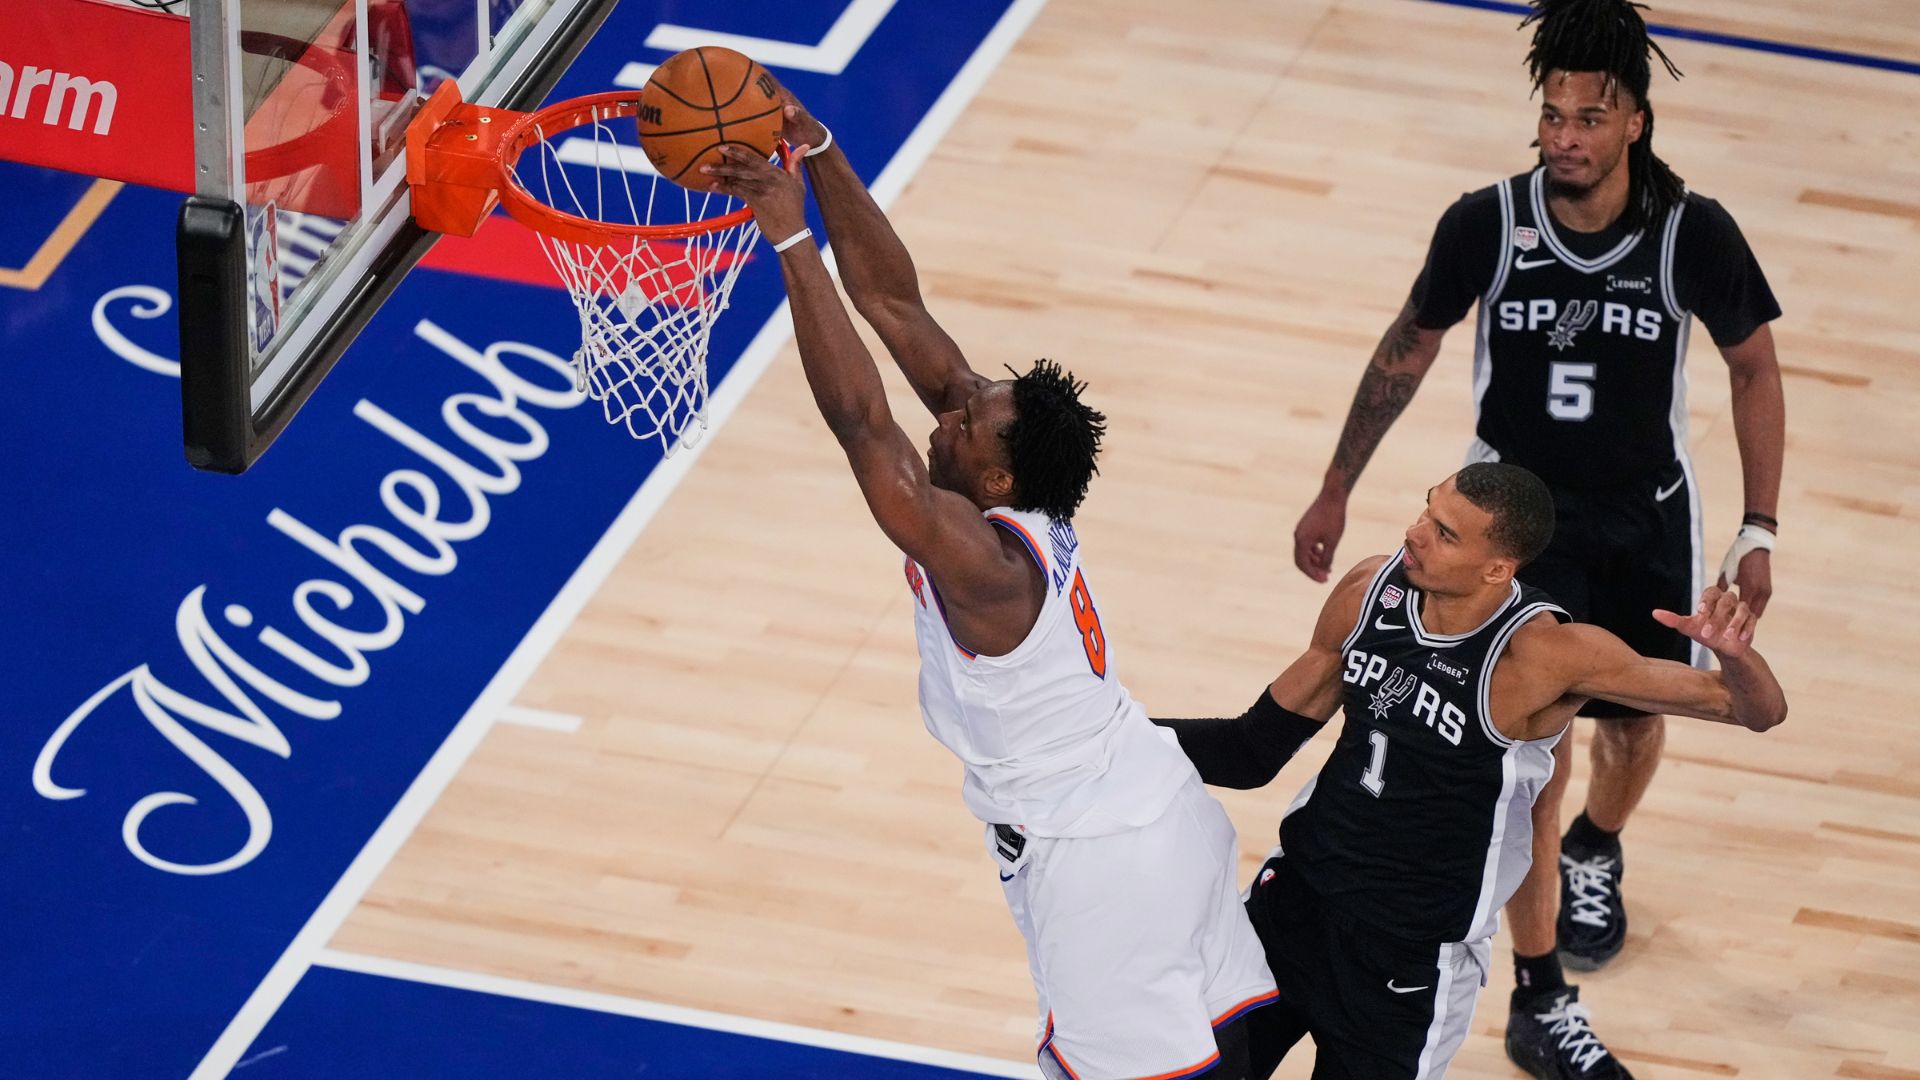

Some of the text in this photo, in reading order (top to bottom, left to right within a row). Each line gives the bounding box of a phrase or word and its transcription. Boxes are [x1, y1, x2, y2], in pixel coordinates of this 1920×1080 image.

[1611, 279, 1646, 290] LEDGER
[1499, 299, 1662, 351] SPURS
[1547, 361, 1597, 421] 5
[32, 318, 588, 875] Michelob
[1069, 566, 1106, 681] 8
[1343, 649, 1467, 746] SPURS
[1432, 658, 1462, 679] LEDGER
[1359, 729, 1388, 798] 1
